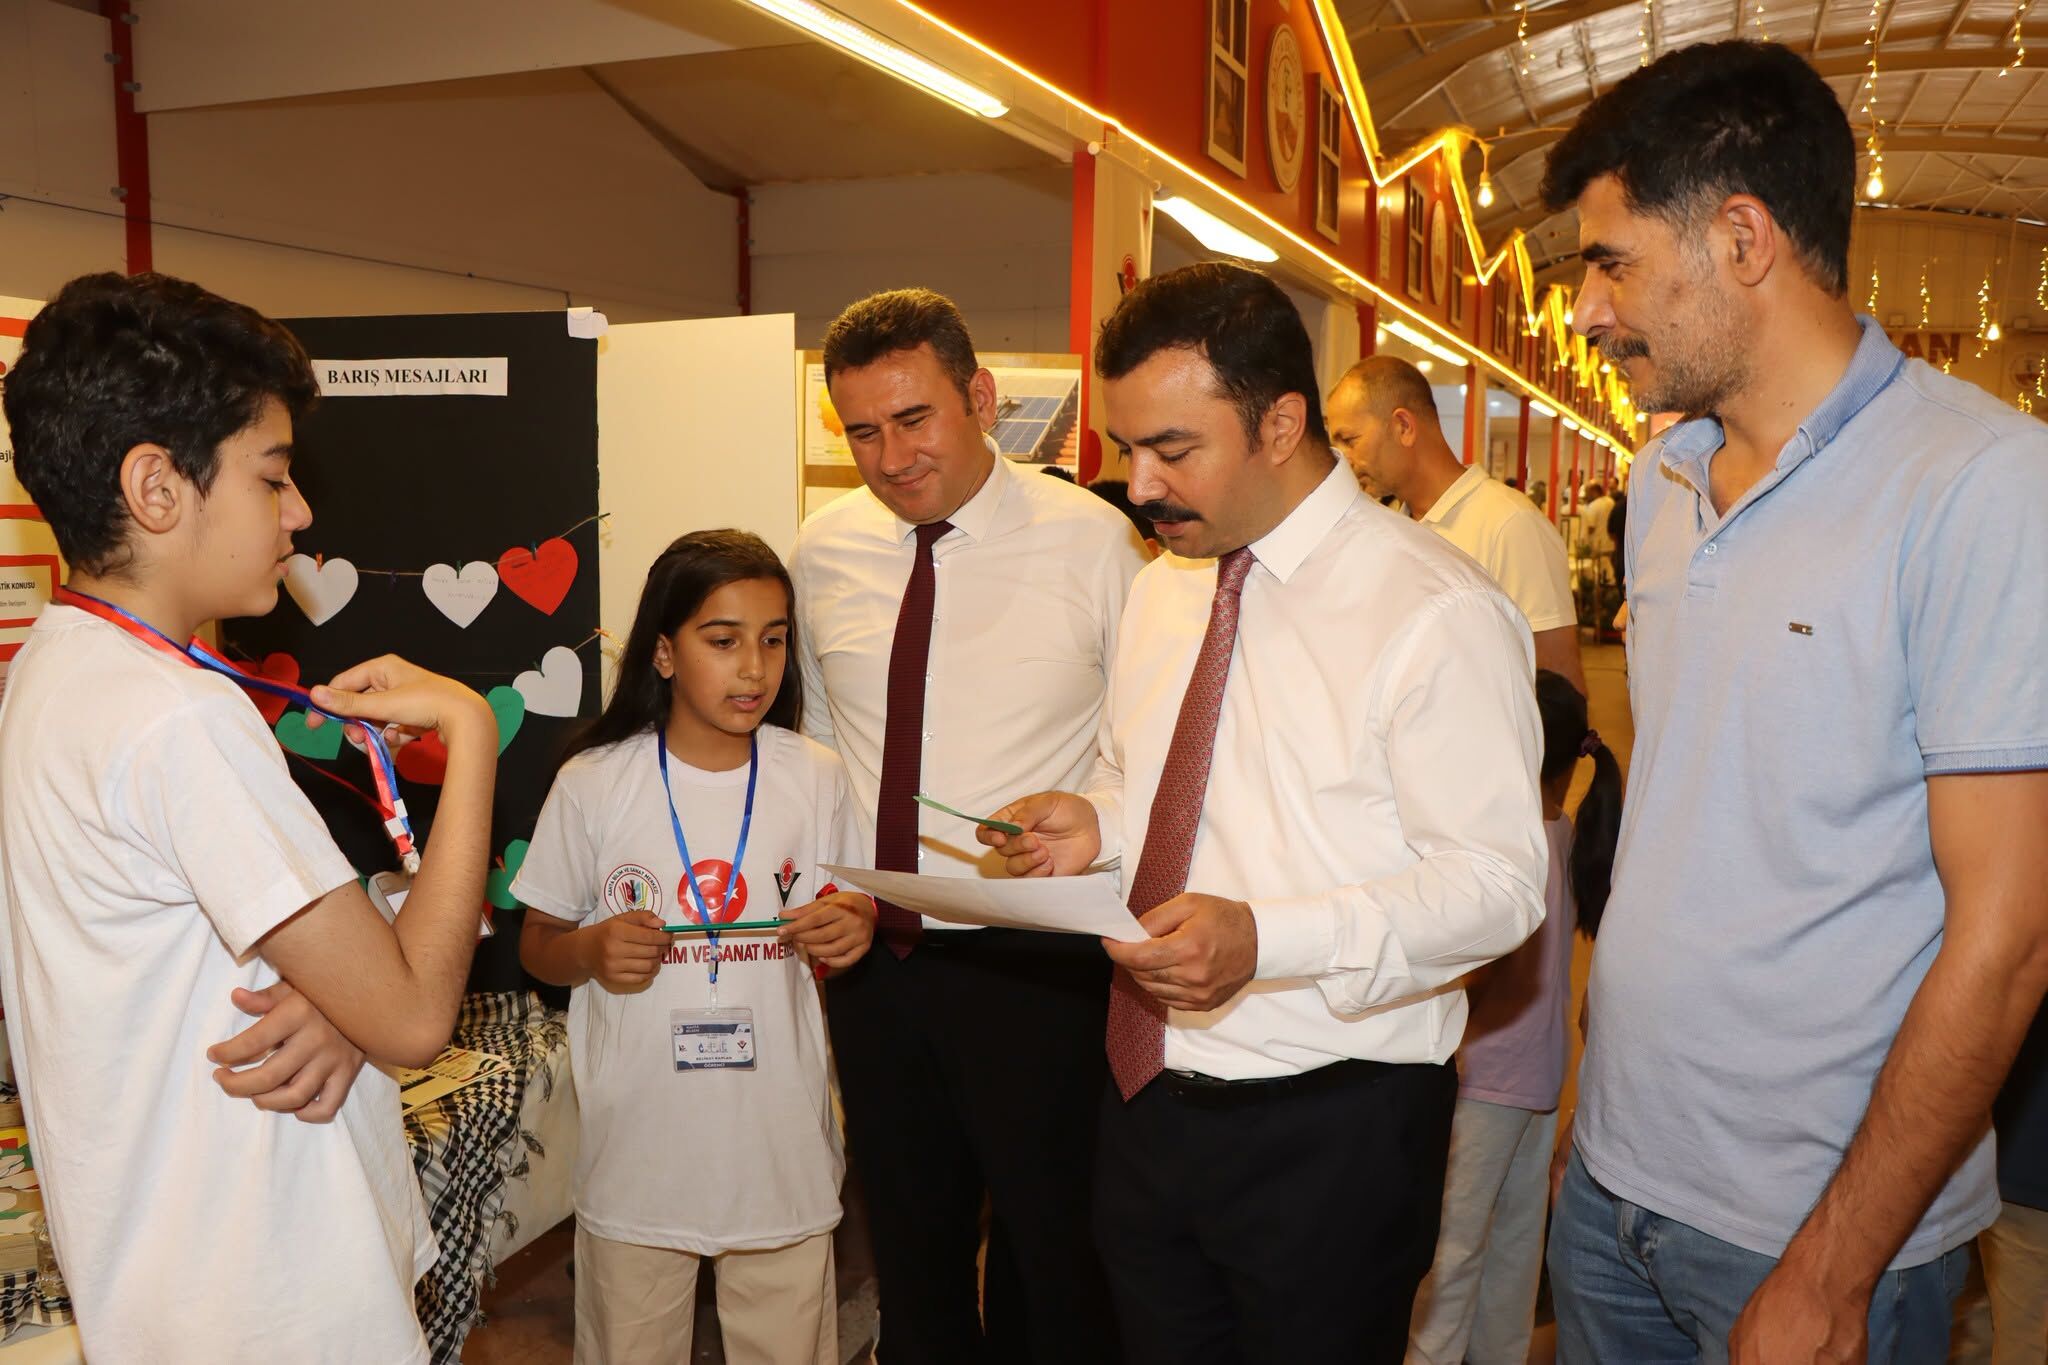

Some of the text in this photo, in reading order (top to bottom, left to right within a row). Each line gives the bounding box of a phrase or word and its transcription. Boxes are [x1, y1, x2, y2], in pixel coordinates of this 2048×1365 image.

[328, 369, 488, 386] BARIŞ MESAJLARI
[11, 581, 36, 590] KONUSU
[691, 945, 710, 963] VE
[716, 943, 761, 963] SANAT
